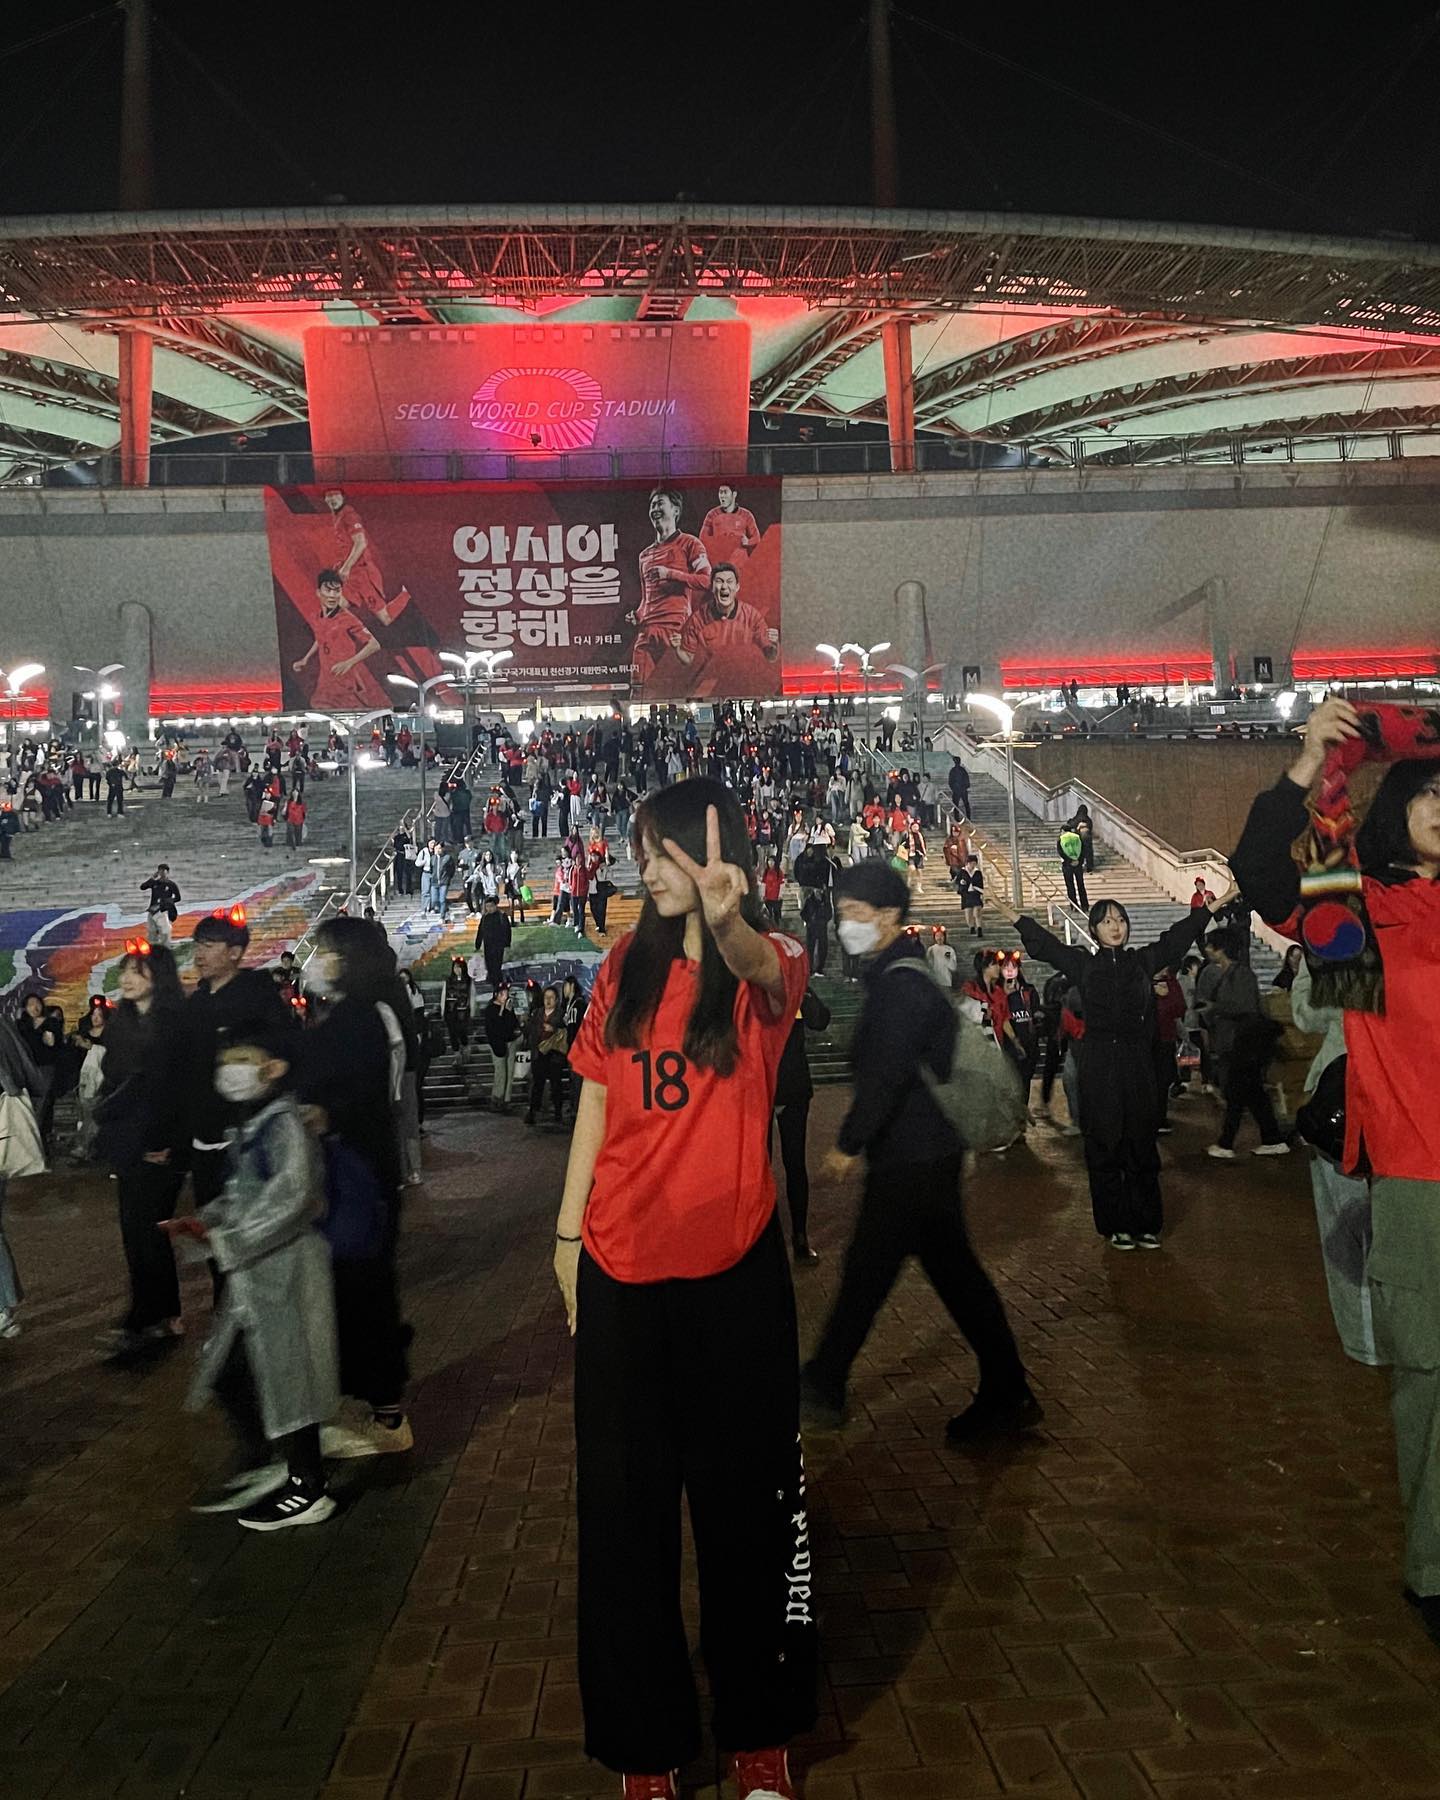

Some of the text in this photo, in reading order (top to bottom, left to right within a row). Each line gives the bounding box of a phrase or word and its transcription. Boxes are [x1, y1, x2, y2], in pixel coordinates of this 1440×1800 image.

[394, 399, 677, 420] SEOUL WORLD CUP STADIUM
[452, 523, 619, 565] 아시아
[458, 566, 621, 607] 정상을
[459, 609, 570, 649] 향해
[573, 634, 622, 646] 다시 카타르
[580, 665, 608, 675] 대한민국
[1259, 662, 1268, 674] N
[631, 1049, 690, 1111] 18
